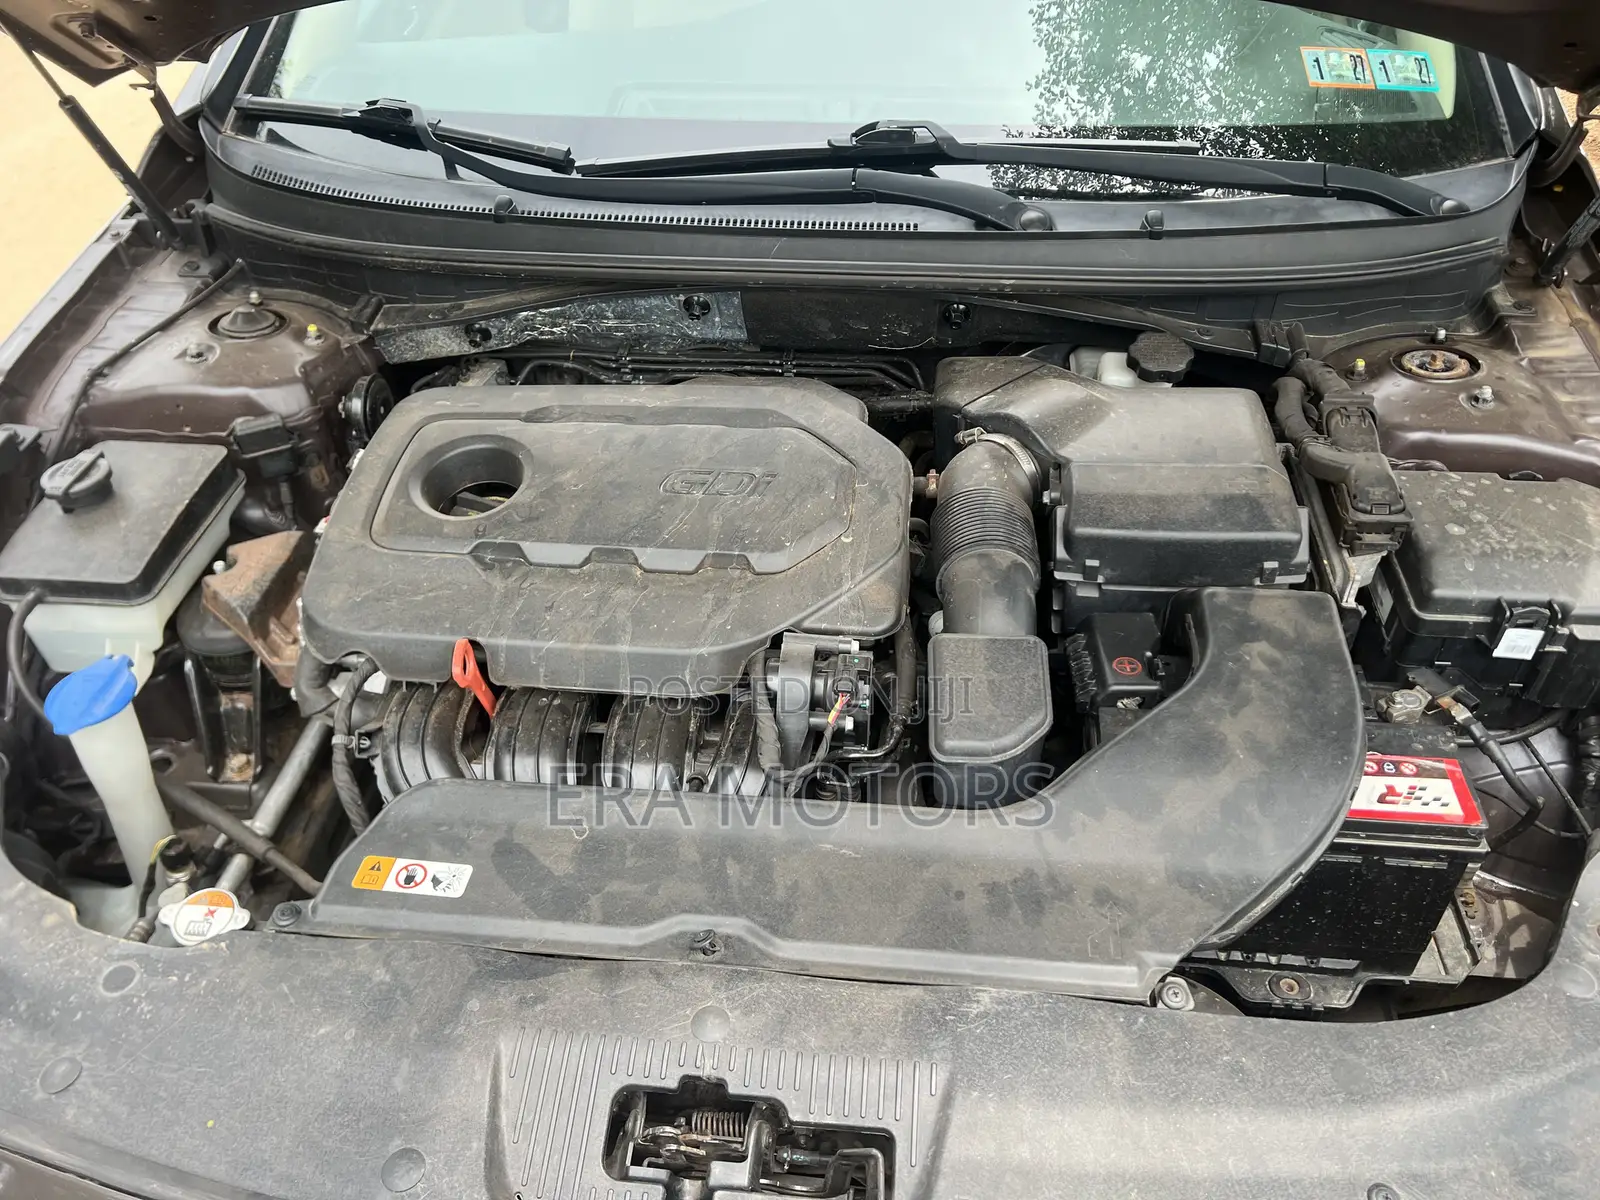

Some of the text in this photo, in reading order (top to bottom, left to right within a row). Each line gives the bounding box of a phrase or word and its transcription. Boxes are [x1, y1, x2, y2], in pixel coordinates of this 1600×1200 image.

[1312, 54, 1367, 84] 1 27
[1378, 57, 1432, 84] 1 27
